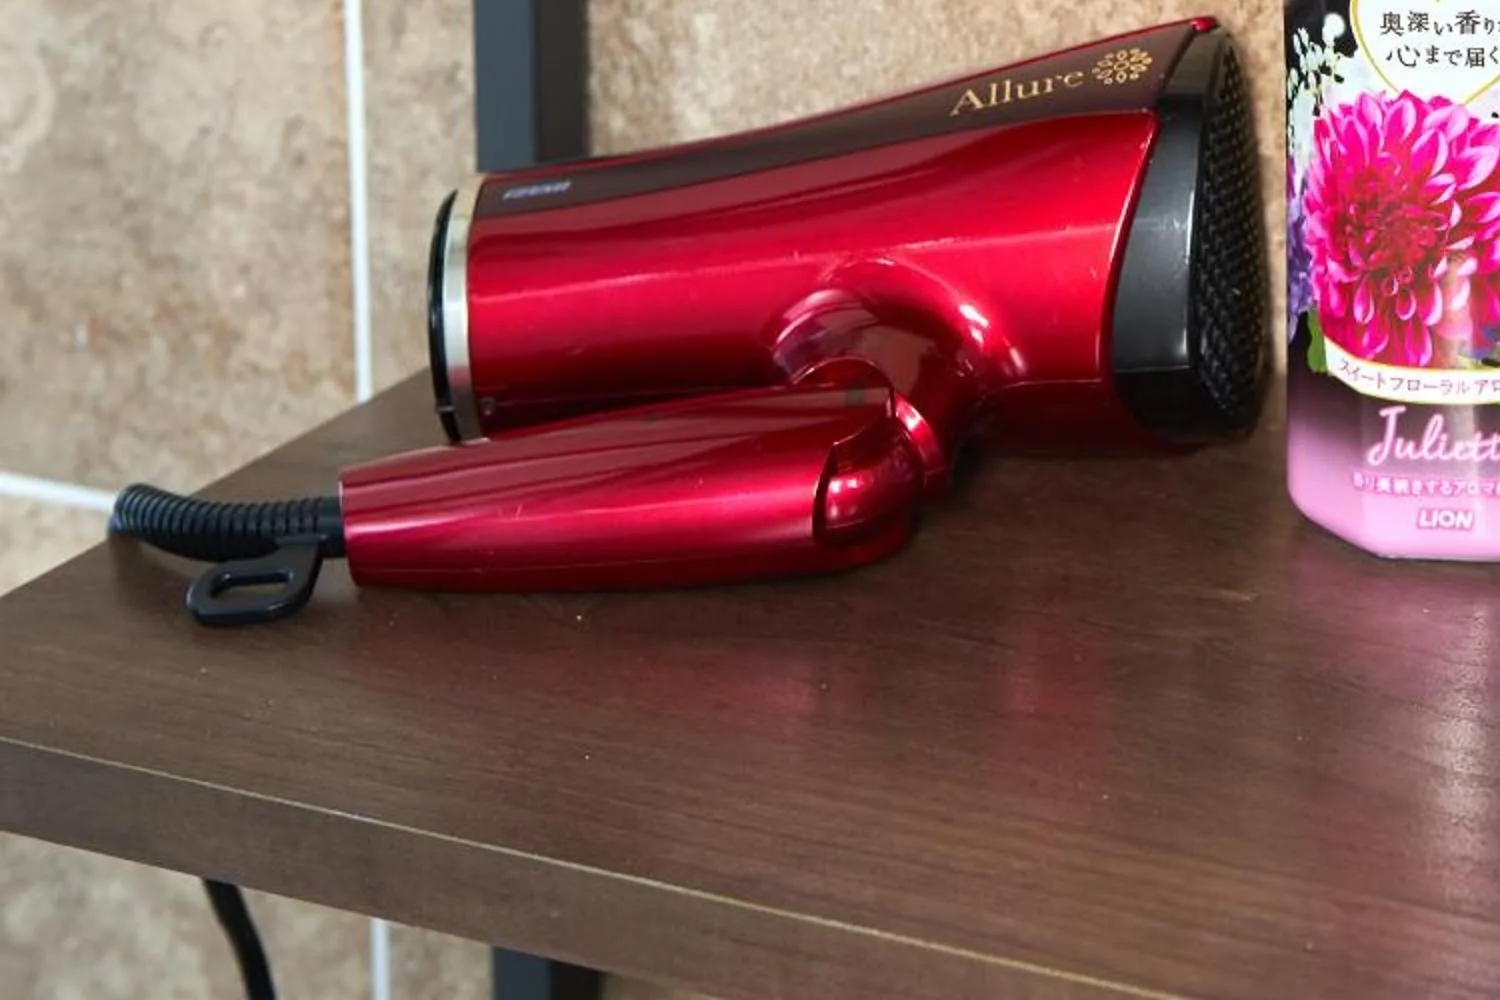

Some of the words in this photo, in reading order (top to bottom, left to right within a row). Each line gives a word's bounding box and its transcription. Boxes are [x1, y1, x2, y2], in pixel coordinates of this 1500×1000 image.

[1386, 46, 1500, 68] 心まで届く
[950, 70, 1084, 117] Allure
[1418, 508, 1474, 528] LION
